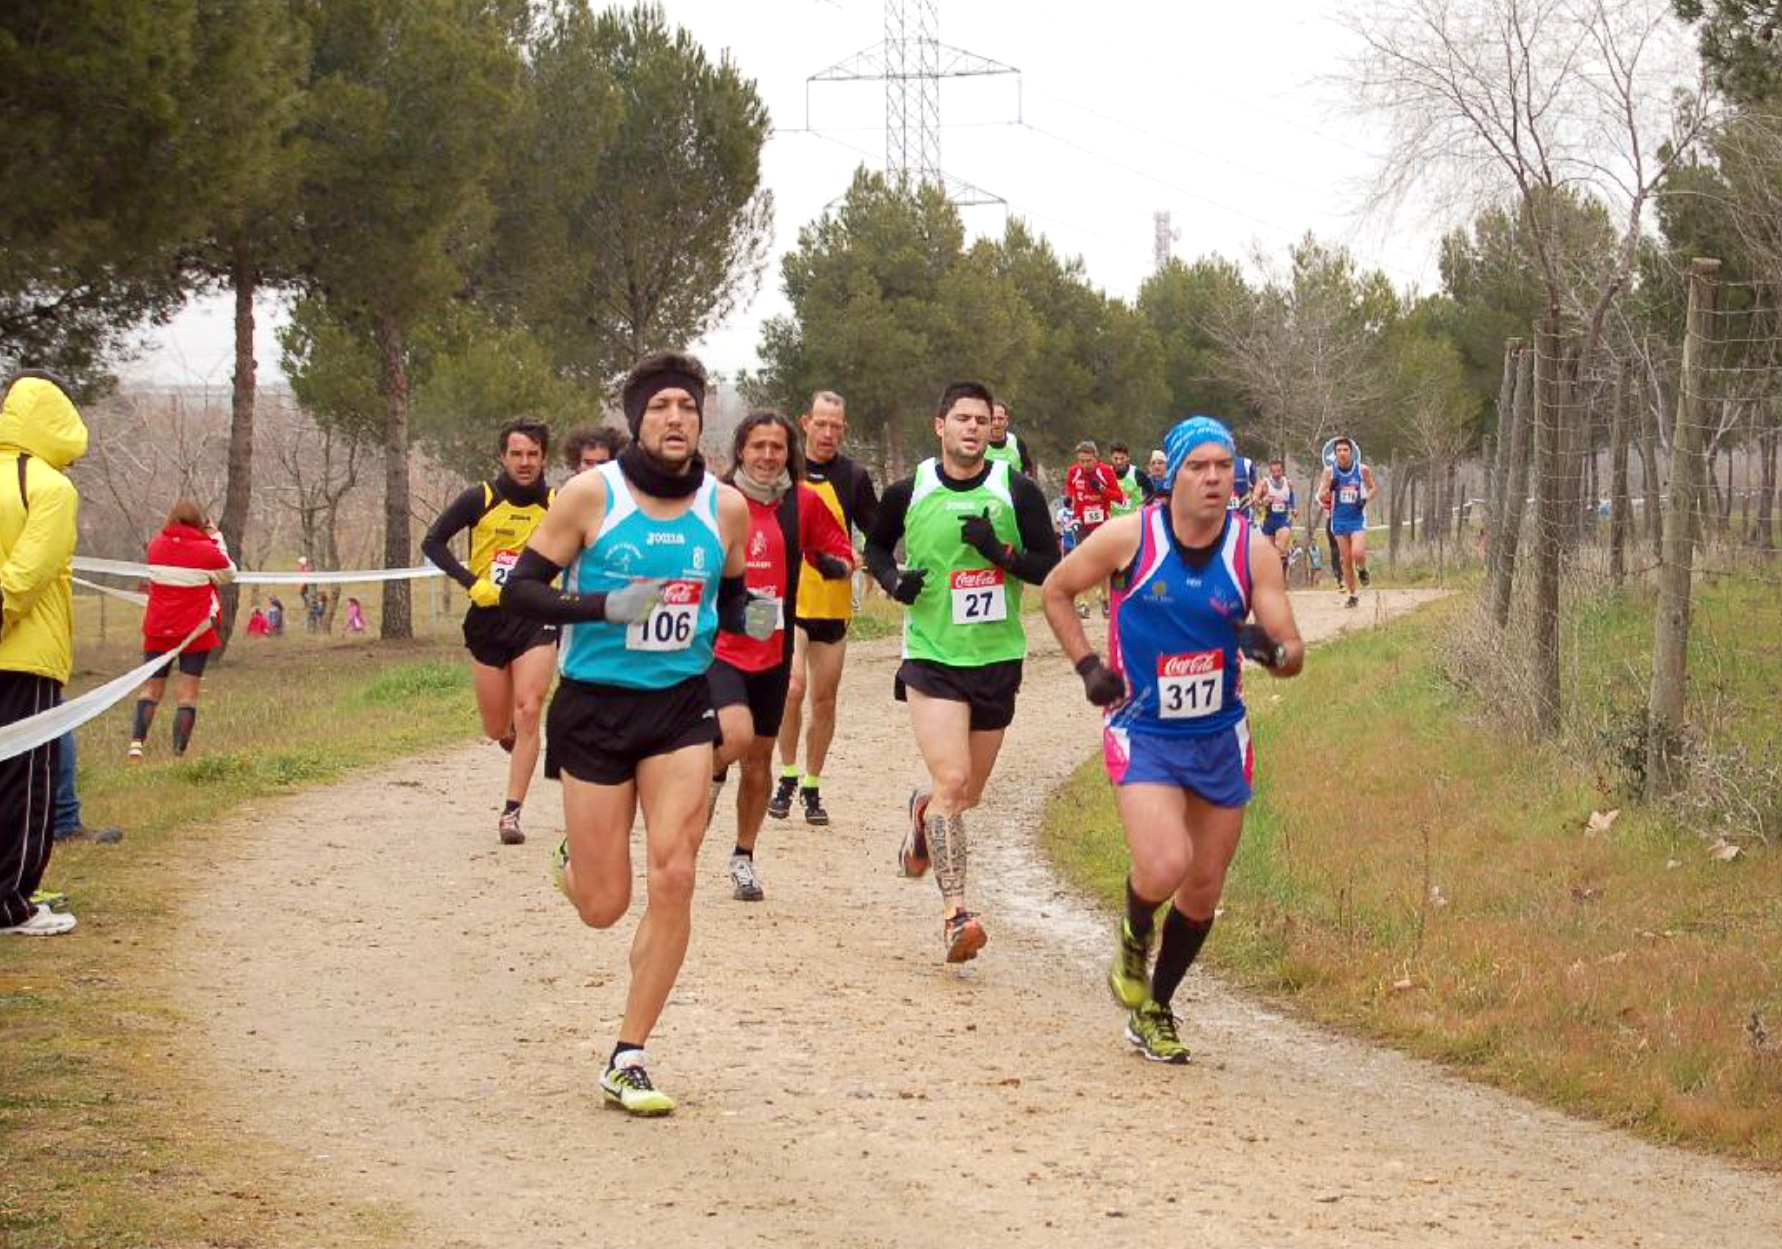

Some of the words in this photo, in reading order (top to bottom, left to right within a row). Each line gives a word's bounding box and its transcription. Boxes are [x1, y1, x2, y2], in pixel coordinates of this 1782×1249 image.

[965, 591, 993, 618] 27
[641, 611, 691, 642] 106
[1166, 678, 1216, 711] 317
